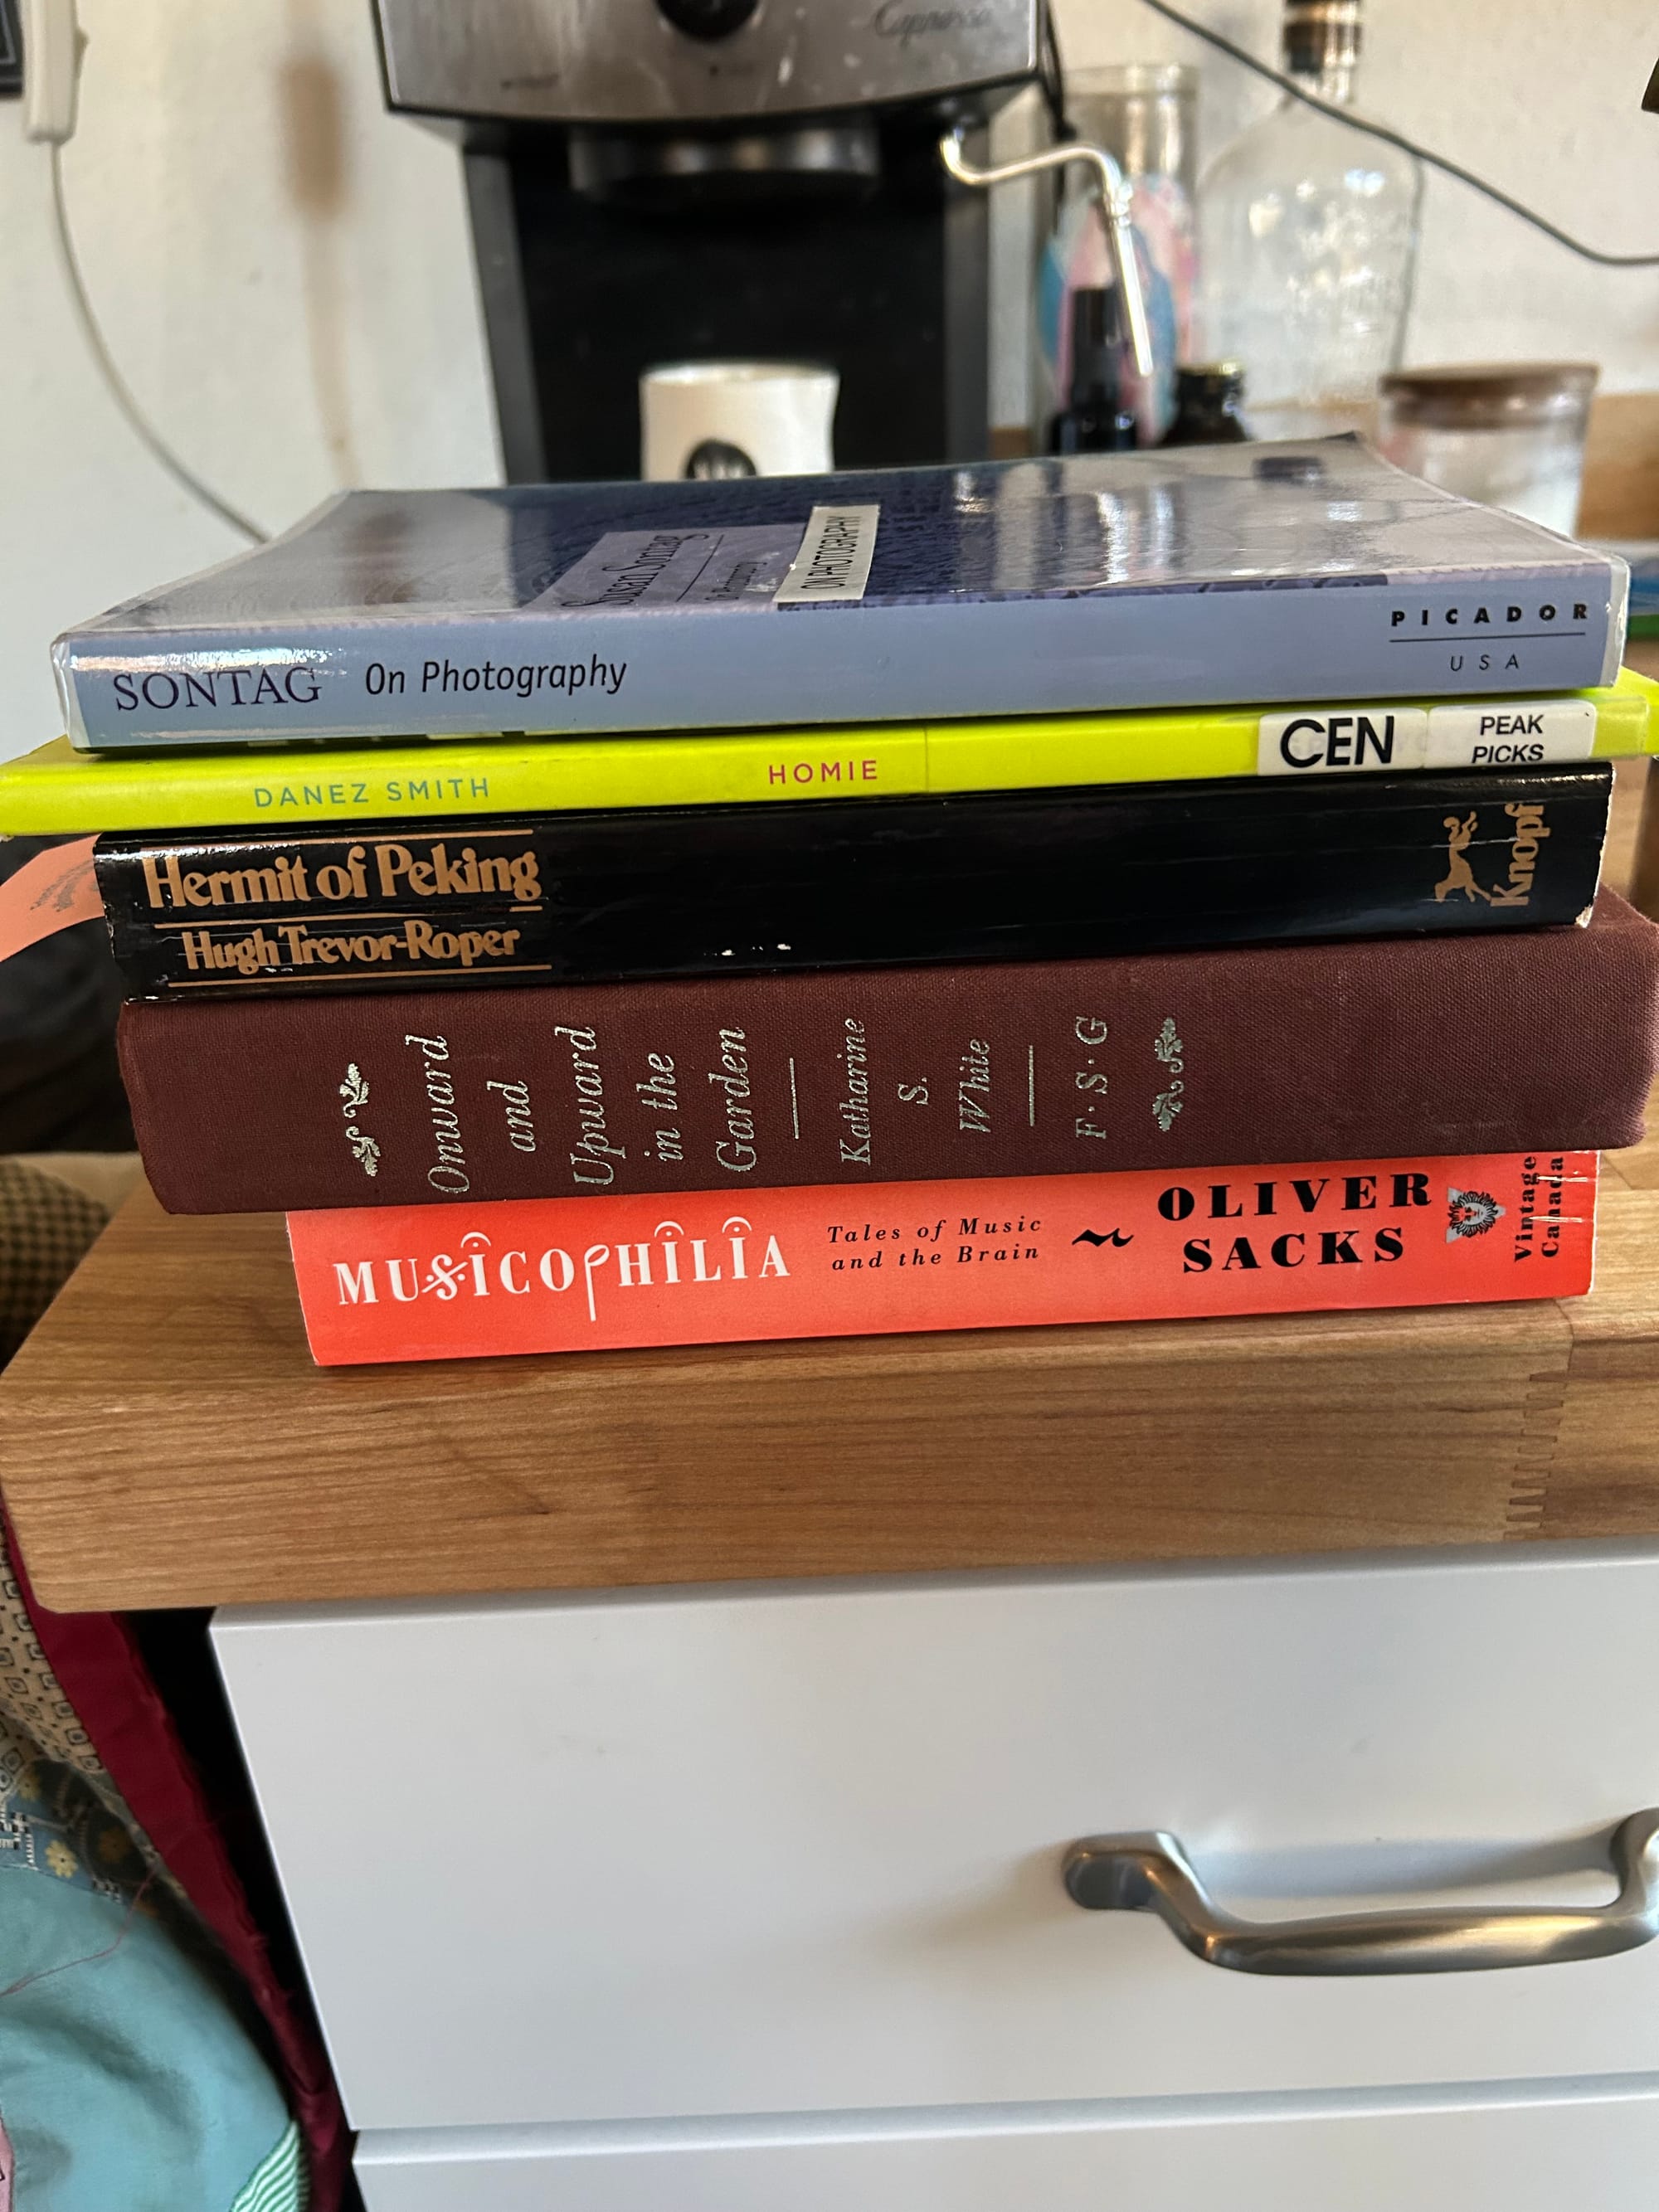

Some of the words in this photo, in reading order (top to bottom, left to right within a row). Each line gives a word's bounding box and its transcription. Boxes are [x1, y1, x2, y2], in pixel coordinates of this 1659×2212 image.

[602, 534, 709, 572] Sontag
[806, 515, 861, 576] PHOTOGRAPHY
[561, 571, 659, 608] Susan
[800, 576, 849, 590] ON
[1390, 603, 1588, 627] PICADOR
[113, 665, 322, 711] SONTAG
[366, 663, 405, 695] On
[421, 654, 627, 698] Photography
[1280, 715, 1394, 768] CEN
[1480, 714, 1543, 736] PEAK
[769, 760, 878, 785] HOMIE
[1472, 743, 1545, 764] PICKS
[254, 783, 368, 807] DANEZ
[387, 778, 489, 801] SMITH
[142, 855, 310, 908] Hermit
[316, 846, 368, 899] of
[375, 843, 542, 902] Peking
[1490, 803, 1550, 907] Knopf
[182, 928, 280, 975] Hugh
[279, 920, 521, 966] Trevor-Roper
[555, 1026, 627, 1185] Upward
[636, 1053, 679, 1112] the
[708, 1027, 757, 1172] Garden
[836, 1017, 871, 1166] Katharine
[898, 1077, 929, 1106] S.
[959, 1038, 991, 1133] White
[405, 1035, 470, 1194] Onward
[487, 1080, 536, 1152] and
[645, 1127, 684, 1162] in
[1157, 1172, 1433, 1222] OLIVER
[1514, 1155, 1540, 1263] Vintage
[1541, 1156, 1564, 1258] Canada
[827, 1223, 902, 1243] Tales
[917, 1219, 947, 1242] of
[958, 1215, 1042, 1236] Music
[1183, 1227, 1404, 1273] SACKS
[832, 1251, 883, 1271] and
[898, 1248, 942, 1266] the
[956, 1243, 1039, 1263] Brain
